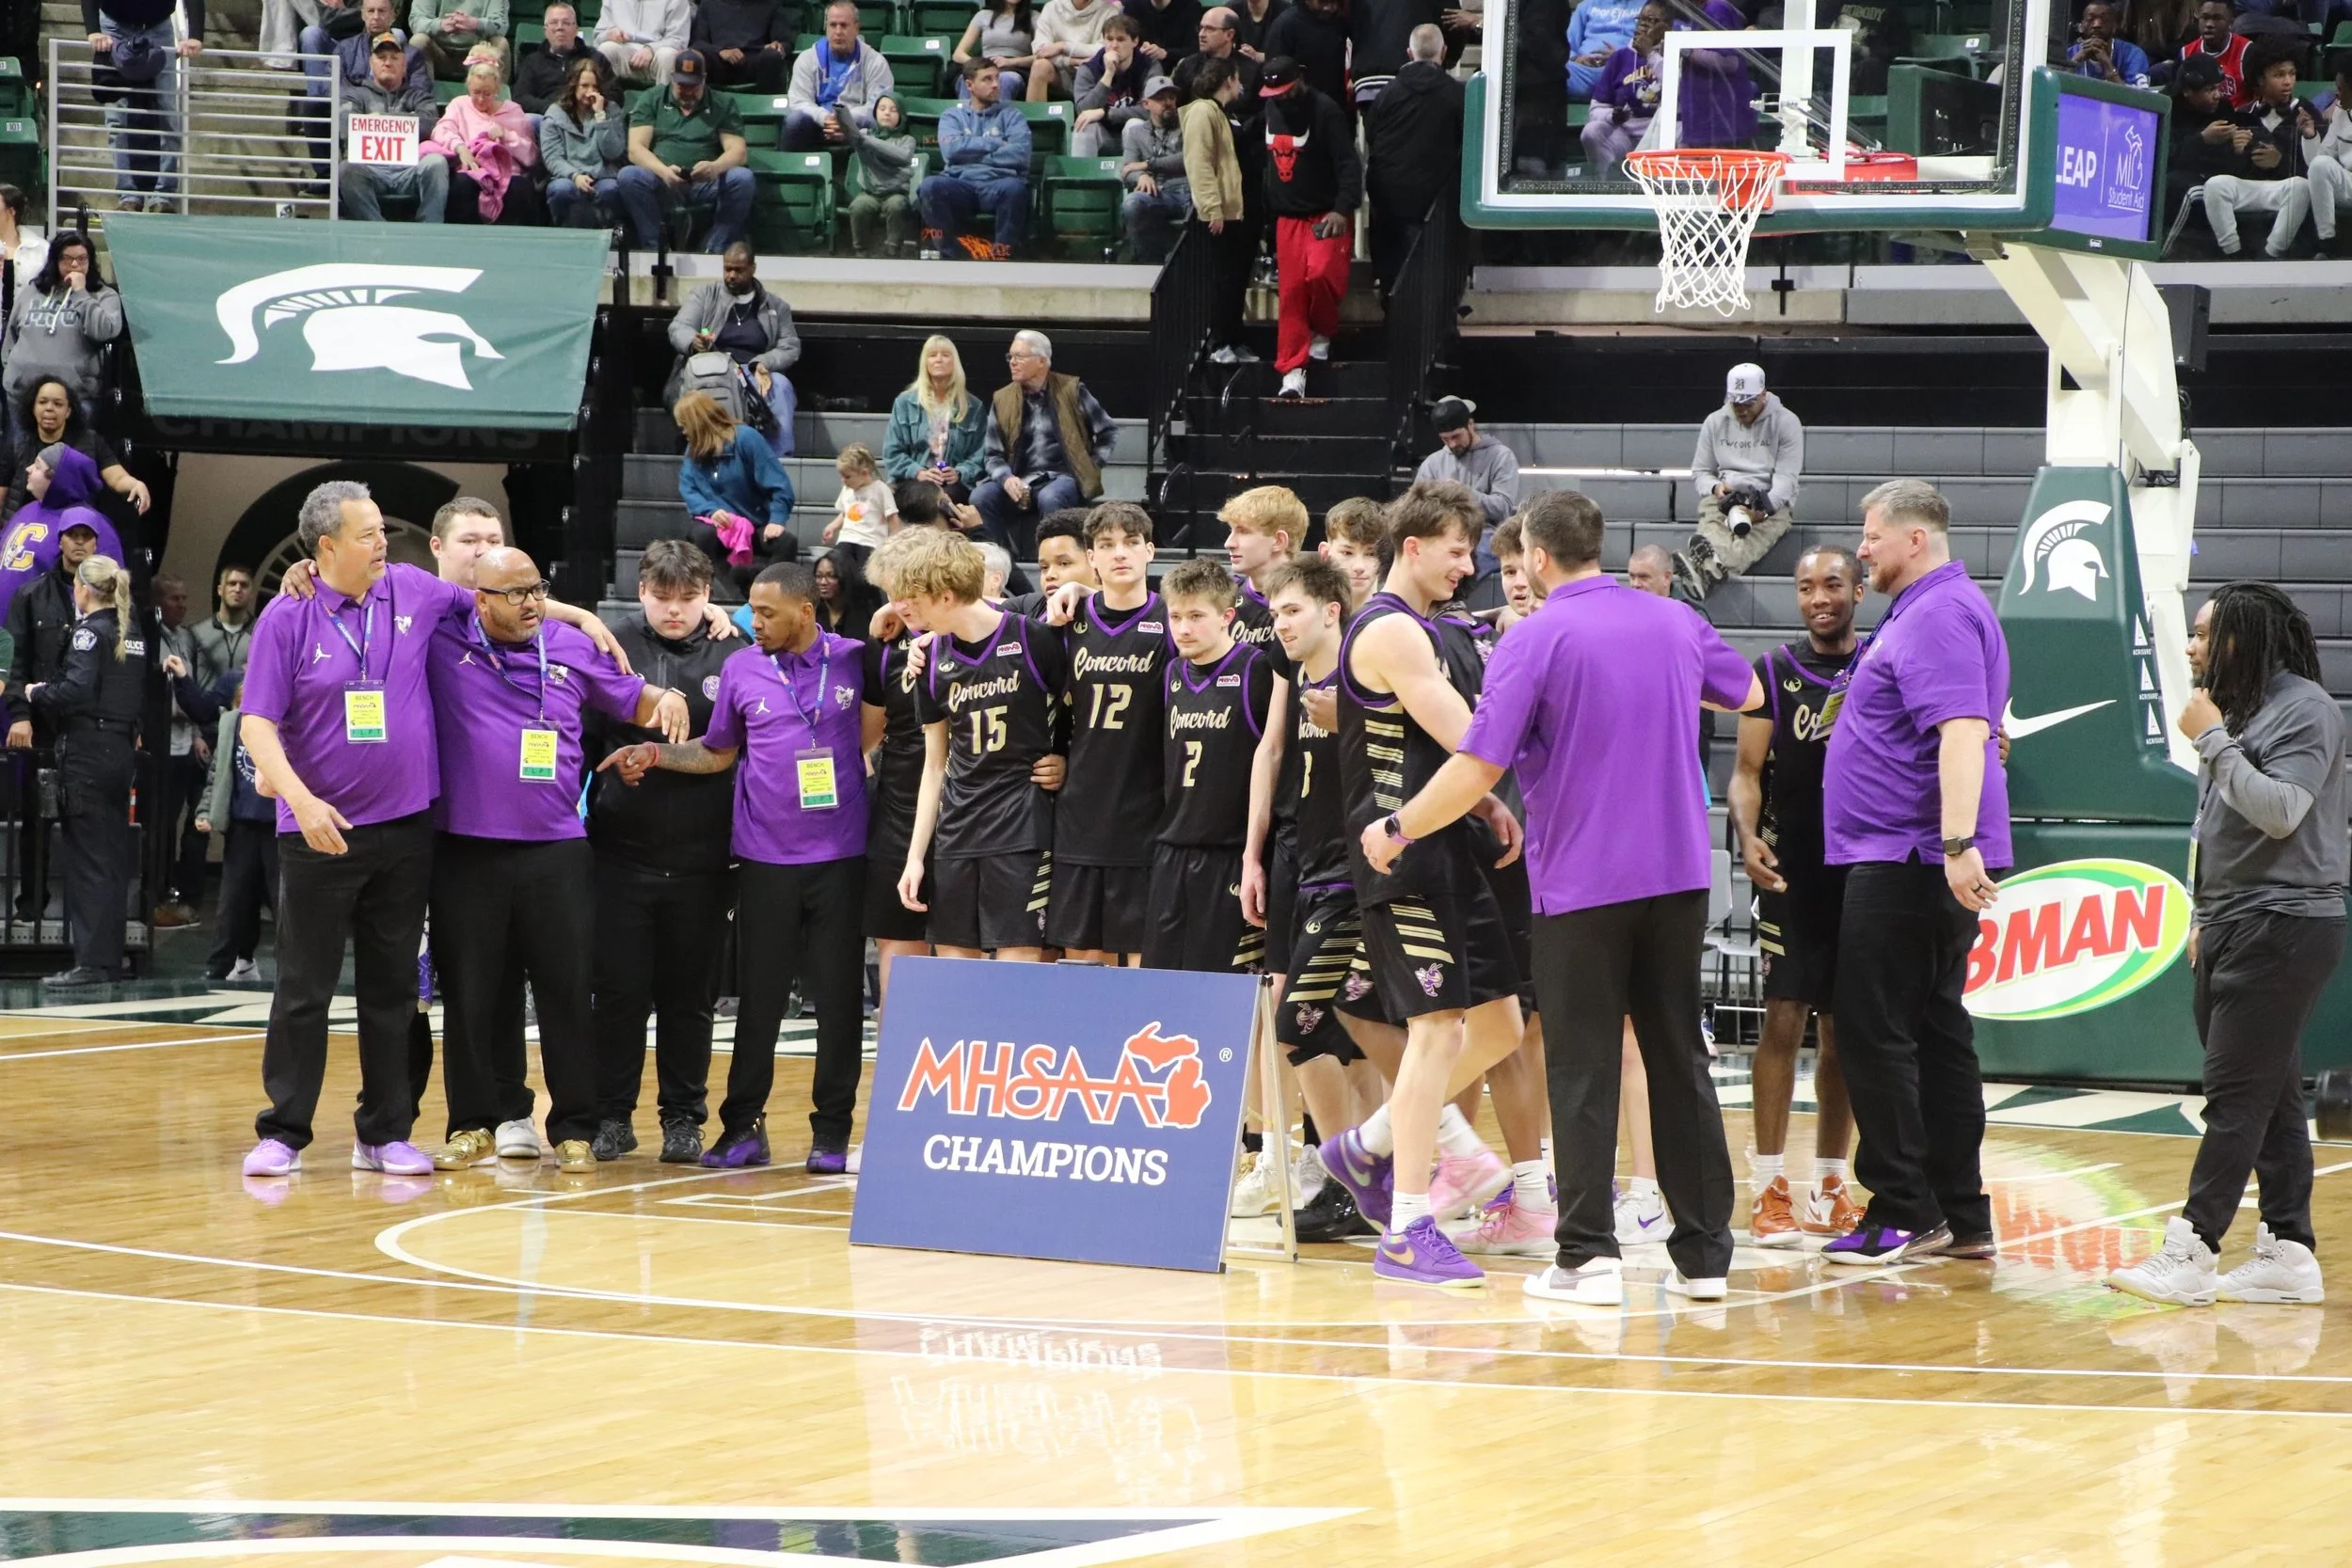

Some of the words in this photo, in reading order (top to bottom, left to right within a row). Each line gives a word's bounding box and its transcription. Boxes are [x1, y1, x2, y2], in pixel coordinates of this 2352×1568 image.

[352, 118, 416, 134] EMERGENCY
[361, 135, 405, 161] EXIT
[2108, 187, 2133, 206] Student
[2134, 191, 2145, 209] Aid
[124, 640, 145, 651] OLICE
[1231, 620, 1275, 643] Conc
[1074, 646, 1154, 681] Concord
[948, 670, 1021, 713] Concord
[1089, 684, 1133, 729] 12
[969, 705, 1009, 754] 15
[1170, 705, 1232, 740] Concord
[1183, 740, 1203, 787] 2
[1963, 884, 2166, 995] BMAN
[897, 1036, 1165, 1128] MHSAA
[923, 1134, 1169, 1186] CHAMPIONS
